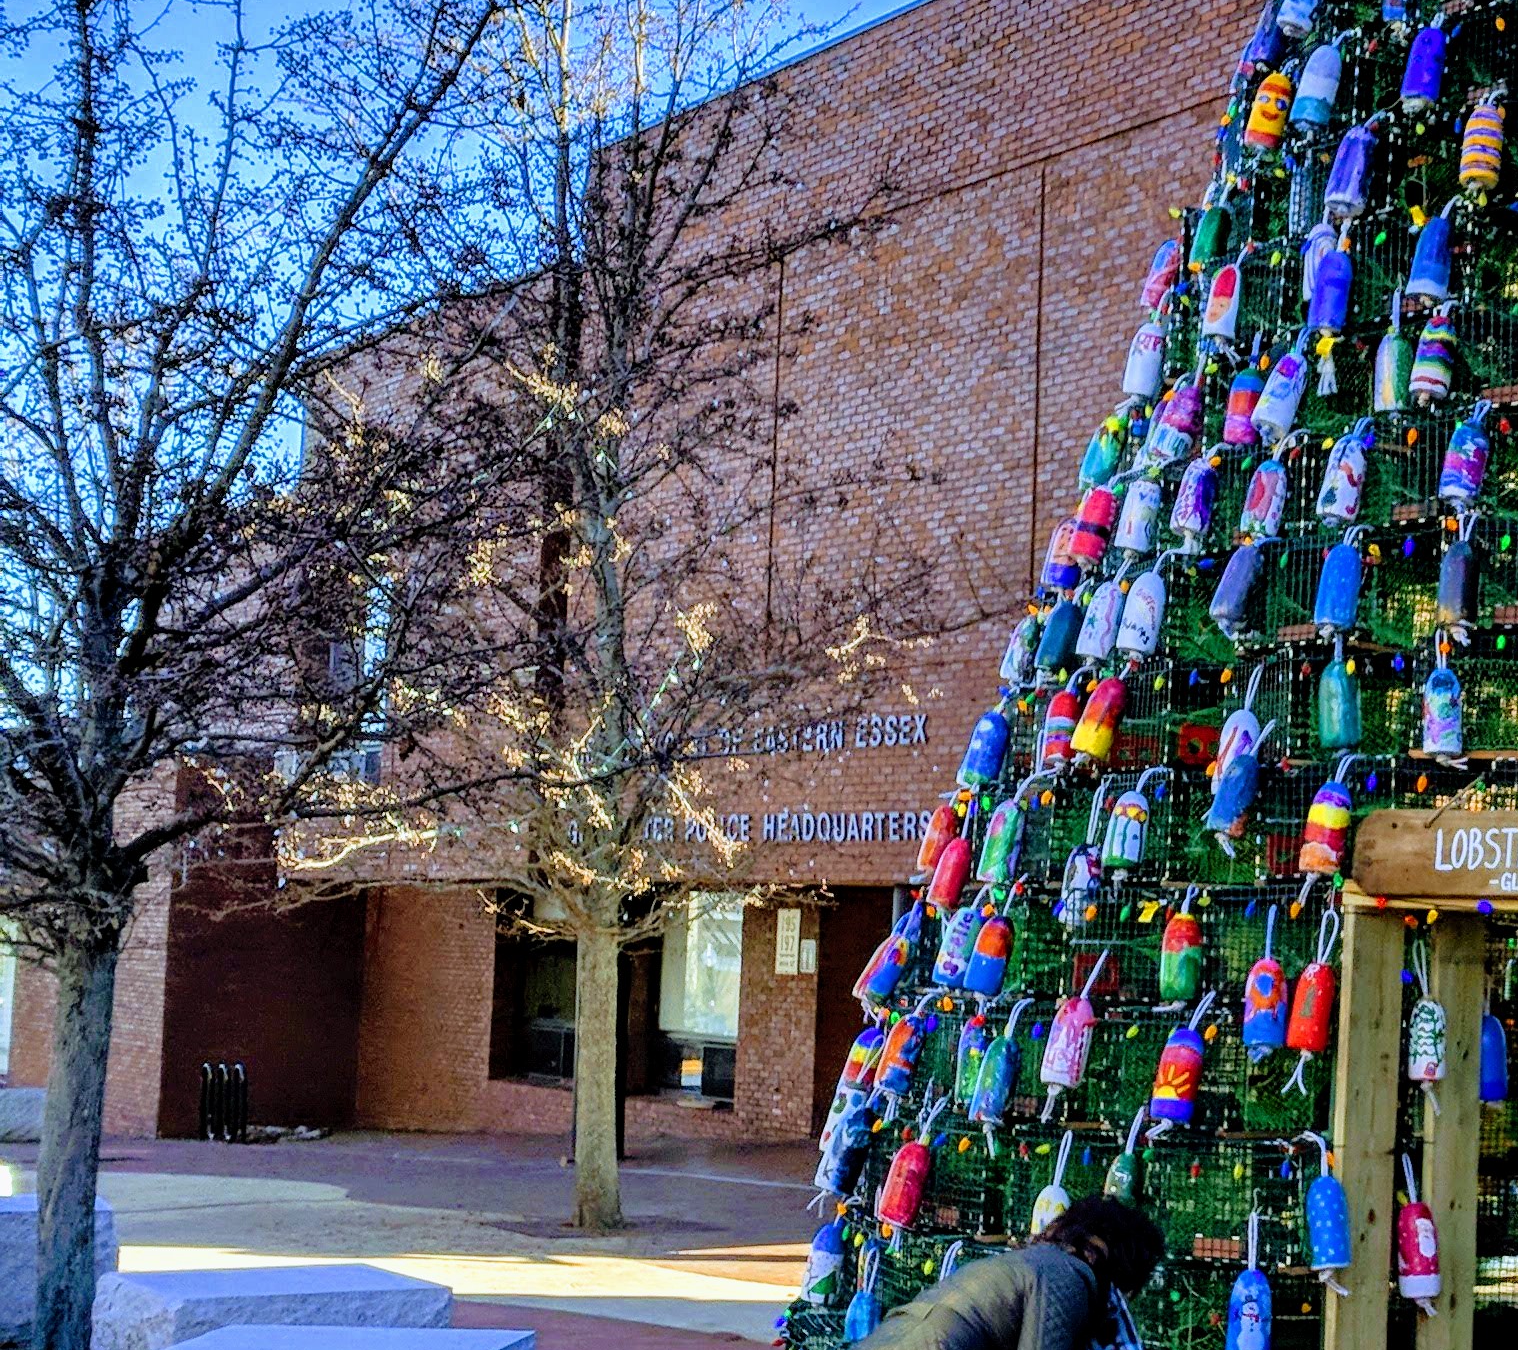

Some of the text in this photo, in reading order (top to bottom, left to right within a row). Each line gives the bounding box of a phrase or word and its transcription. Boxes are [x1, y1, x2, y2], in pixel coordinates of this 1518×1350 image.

[855, 713, 928, 748] ESSEX
[684, 813, 751, 843] POICE
[763, 810, 933, 843] HEADQUARTERS
